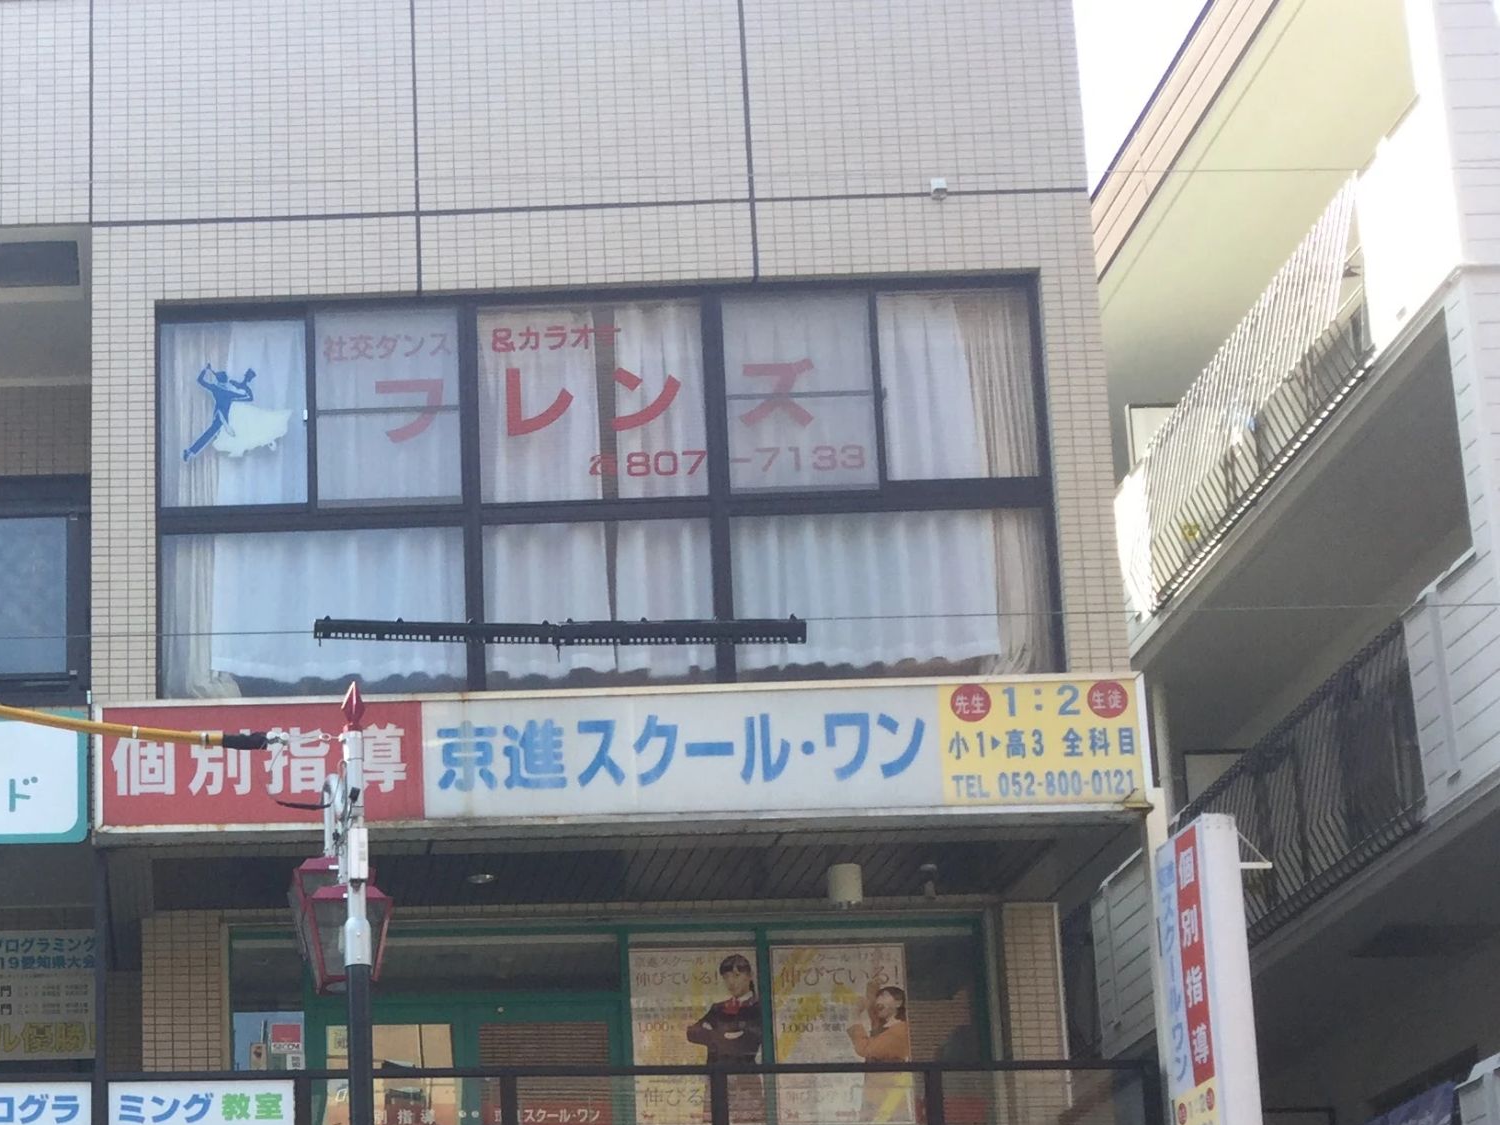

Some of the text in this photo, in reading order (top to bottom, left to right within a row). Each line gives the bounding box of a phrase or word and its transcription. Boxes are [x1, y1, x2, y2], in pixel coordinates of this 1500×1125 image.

[322, 332, 452, 362] 社交ダンス
[375, 357, 815, 444] フレンズ
[953, 691, 989, 715] 先生
[1089, 682, 1126, 713] 生徒
[111, 712, 926, 797] 個別指導 京進スクール・ワン
[1062, 727, 1136, 757] 全科目
[952, 769, 1135, 799] TEL 052-800-0121
